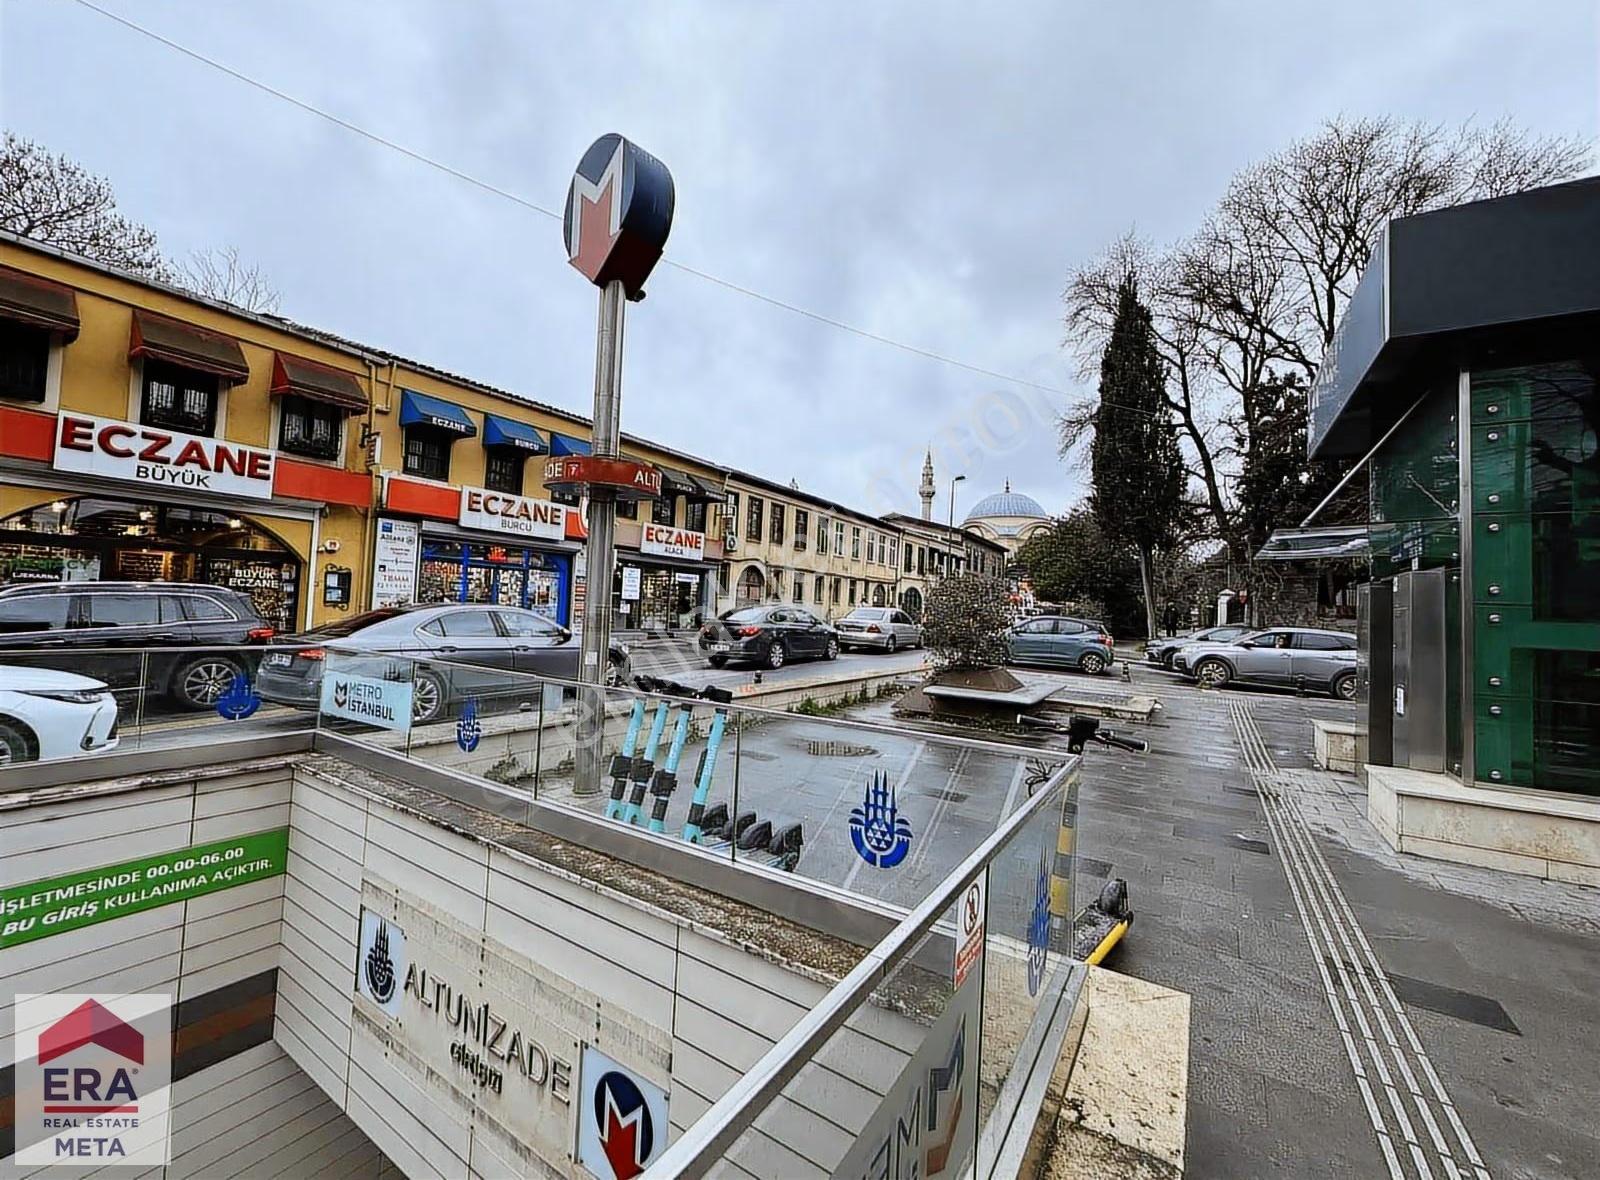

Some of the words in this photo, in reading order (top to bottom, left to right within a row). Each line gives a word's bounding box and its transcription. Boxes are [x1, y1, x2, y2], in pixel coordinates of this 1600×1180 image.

[431, 416, 466, 433] ECZANE
[61, 416, 271, 481] ECZANE
[136, 464, 210, 489] BÜYÜK
[467, 490, 562, 526] ECZANE
[501, 519, 532, 532] BURCU
[645, 526, 702, 549] ECZANE
[228, 577, 279, 589] ECZANE
[349, 681, 383, 700] METRO
[146, 847, 244, 880] 00.00-06.00
[2, 917, 36, 936] BU
[42, 899, 98, 925] GİRİŞ
[105, 873, 207, 910] KULLANIMA
[212, 858, 273, 882] AÇIKTIR.
[403, 962, 572, 1107] ALTUNİZADE
